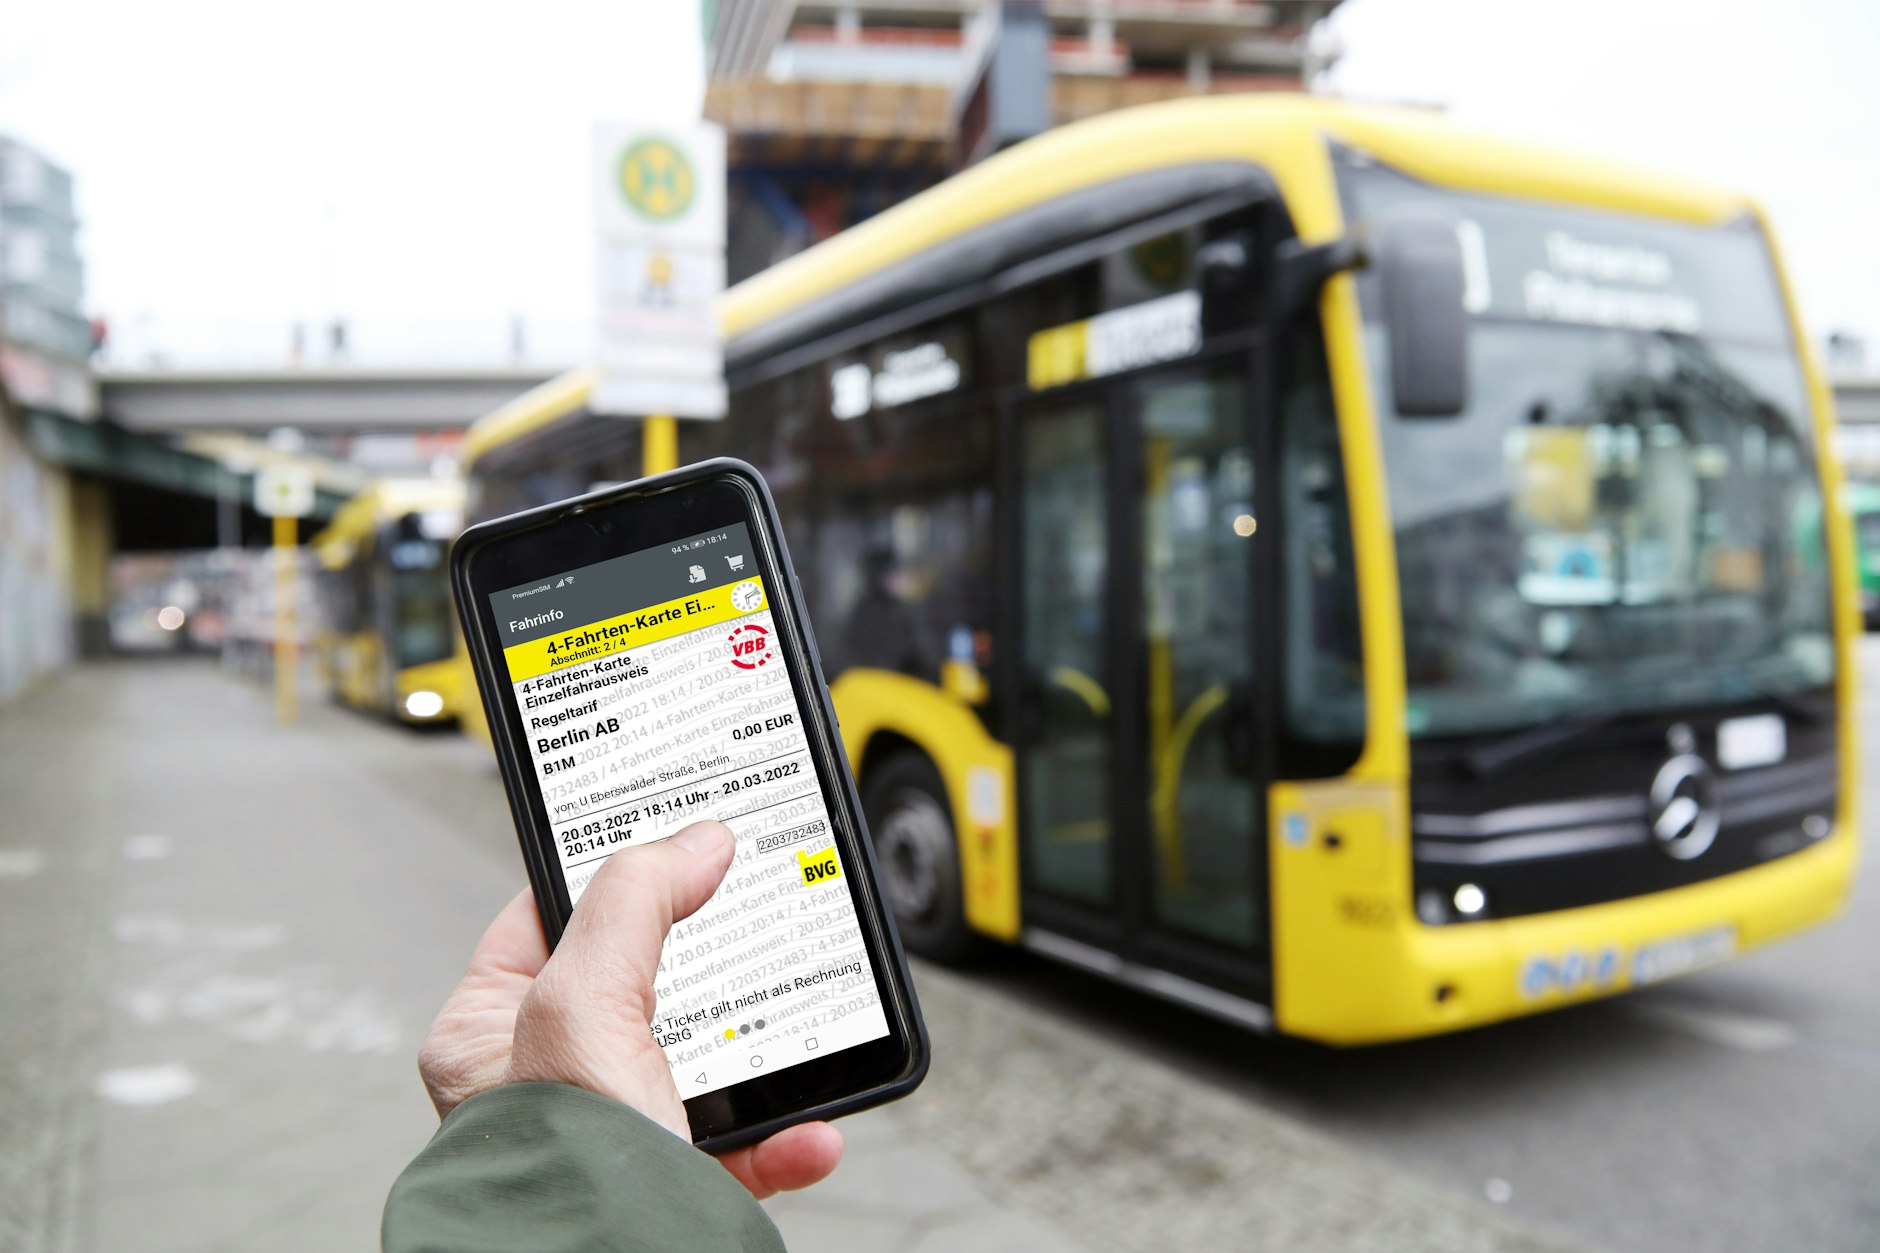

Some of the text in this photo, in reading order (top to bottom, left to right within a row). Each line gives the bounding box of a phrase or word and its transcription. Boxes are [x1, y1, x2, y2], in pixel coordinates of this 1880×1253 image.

[671, 546, 682, 555] 94
[706, 533, 727, 544] 18:14
[512, 584, 551, 600] PremiumSIM
[509, 609, 564, 633] Fahrinfo
[547, 609, 682, 654] 4-Fahrten-Karte
[551, 646, 602, 667] Abschnitt:
[603, 642, 611, 651] 2
[620, 638, 626, 646] 4
[732, 637, 766, 657] VBB
[523, 657, 631, 694] 4-Fahrten-Karte
[525, 665, 649, 709] Einzelfahrausweis
[531, 699, 597, 730] Regeltarif
[732, 714, 794, 740] 0,00 EUR
[537, 729, 590, 754] Berlin
[595, 718, 620, 738] AB
[543, 756, 576, 775] B1M
[554, 802, 575, 813] von:
[579, 797, 588, 806] U
[590, 778, 656, 803] Eberswalder
[659, 767, 697, 782] Straße,
[699, 756, 730, 771] Berlin
[562, 810, 641, 843] 20.03.2022
[644, 797, 683, 818] 18:14
[685, 791, 710, 805] Uhr
[722, 762, 800, 795] 20.03.2022
[565, 836, 605, 857] 20:14
[608, 829, 632, 844] Uhr
[758, 822, 825, 850] 2203732483
[804, 860, 836, 882] BVG
[674, 888, 776, 942] 4-Fahrten-Karte
[676, 924, 747, 965] 20.03.2022
[672, 930, 787, 993] Einzelfahrausweis
[727, 948, 808, 992] 2203732483
[664, 1009, 708, 1029] Ticket
[711, 1001, 732, 1019] gilt
[735, 990, 769, 1009] nicht
[772, 983, 792, 997] als
[794, 962, 862, 990] Rechnung
[657, 1028, 692, 1048] UStG
